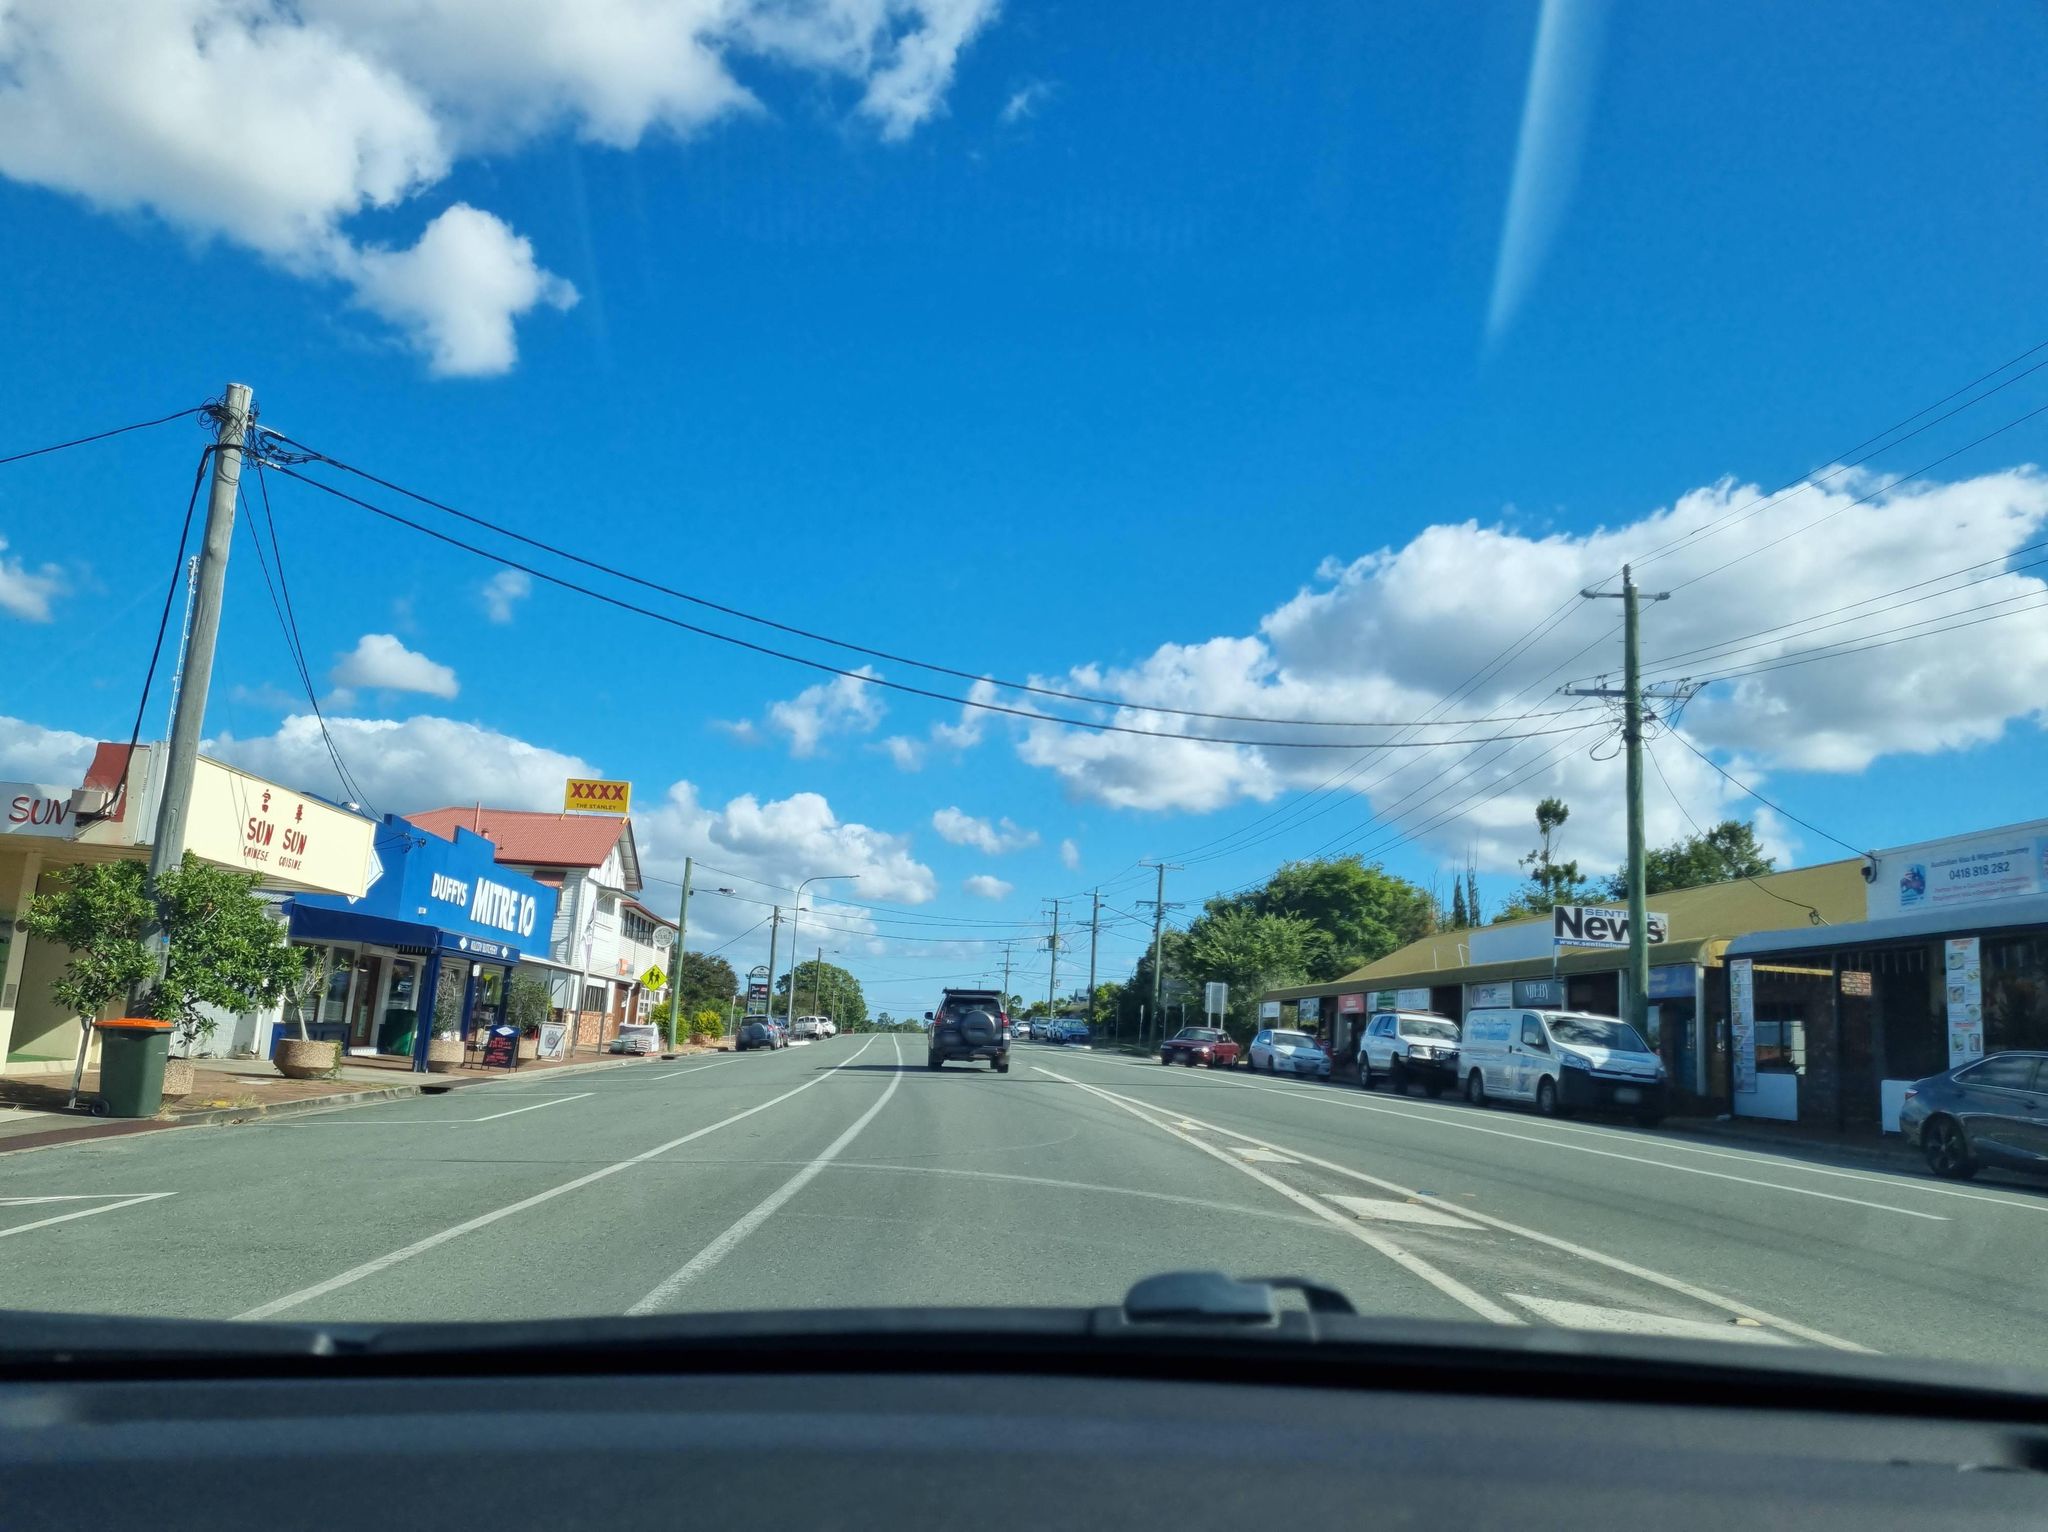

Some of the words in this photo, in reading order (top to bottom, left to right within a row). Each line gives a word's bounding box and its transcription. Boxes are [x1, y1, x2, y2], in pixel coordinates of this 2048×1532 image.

[571, 783, 624, 800] XXXX
[9, 796, 71, 825] SUN
[247, 817, 275, 846] SUN
[282, 828, 308, 855] SUN
[243, 846, 270, 861] CHINESE
[1949, 868, 1971, 880] 0418
[1973, 865, 1990, 876] 818
[1992, 861, 2010, 874] 282
[431, 873, 468, 907] DUFFYS
[470, 877, 518, 932] MITRE
[518, 894, 535, 937] 10
[1585, 908, 1656, 920] SENTIL
